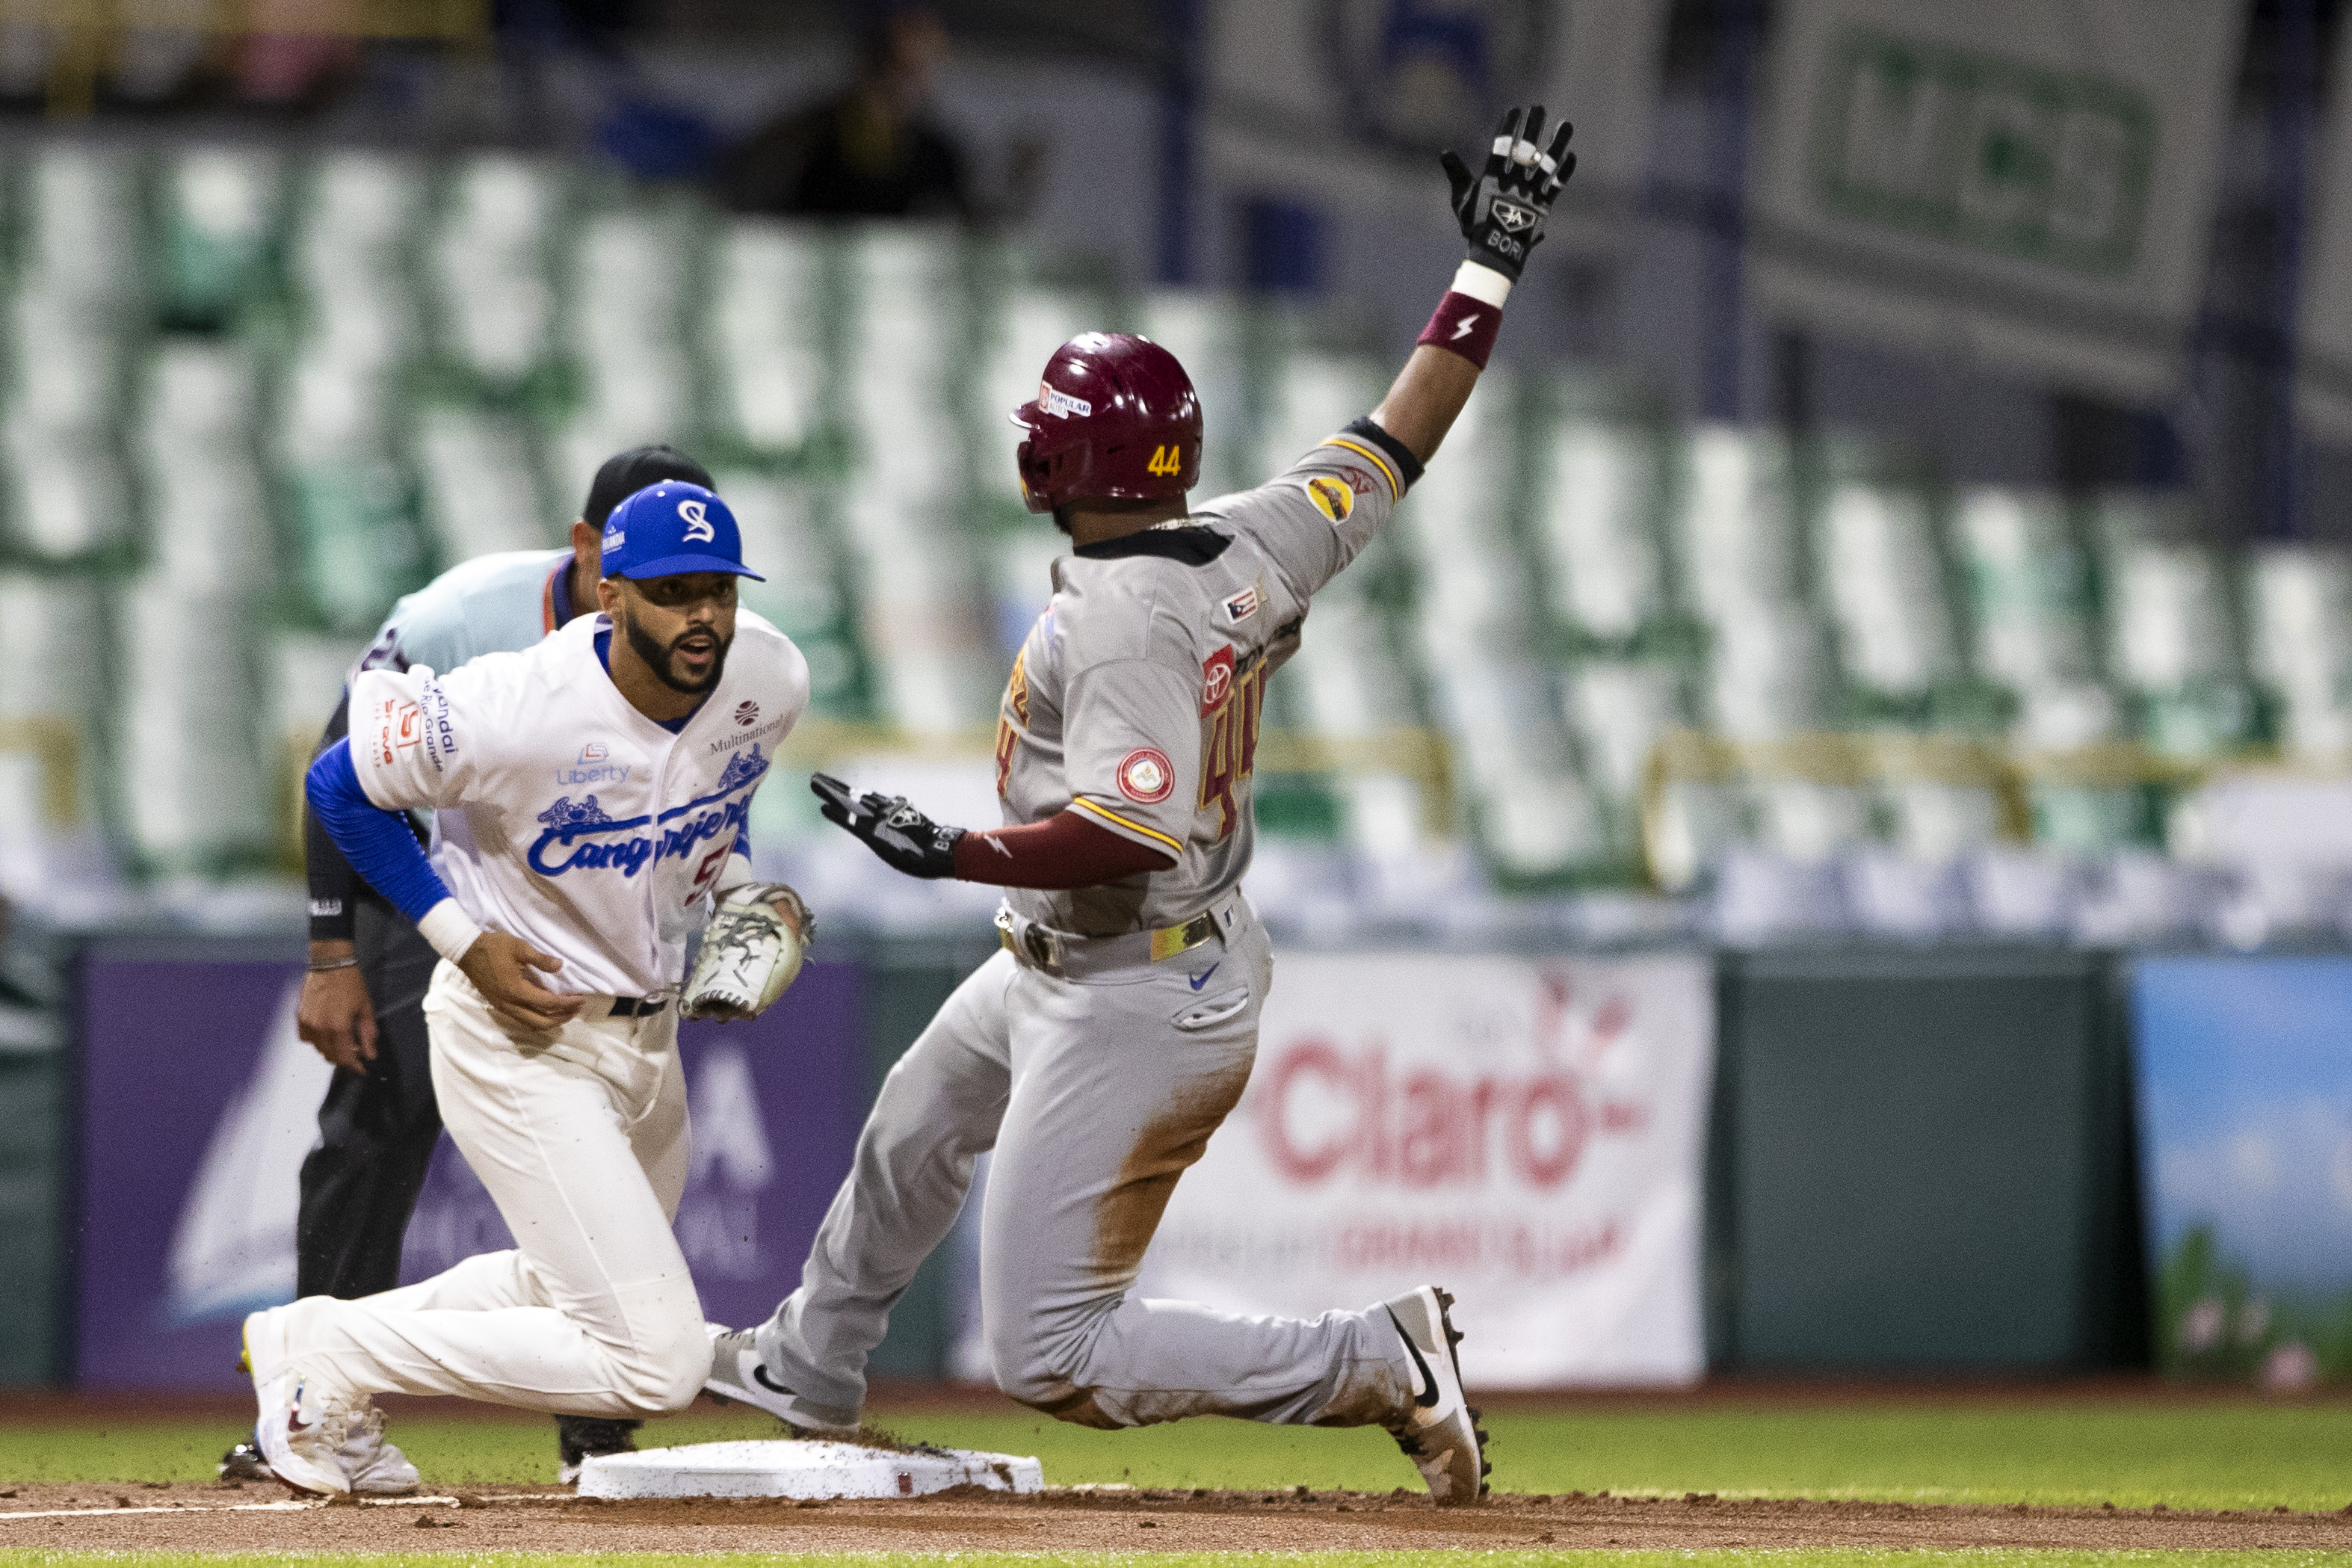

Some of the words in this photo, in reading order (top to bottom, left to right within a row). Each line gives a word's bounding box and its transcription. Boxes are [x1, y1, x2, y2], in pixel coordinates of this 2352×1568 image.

[1050, 392, 1090, 412] POPULAR
[1147, 445, 1181, 477] 44
[677, 499, 715, 543] S
[425, 717, 444, 773] Grande
[557, 765, 631, 785] Liberty
[1256, 1034, 1587, 1191] Claro
